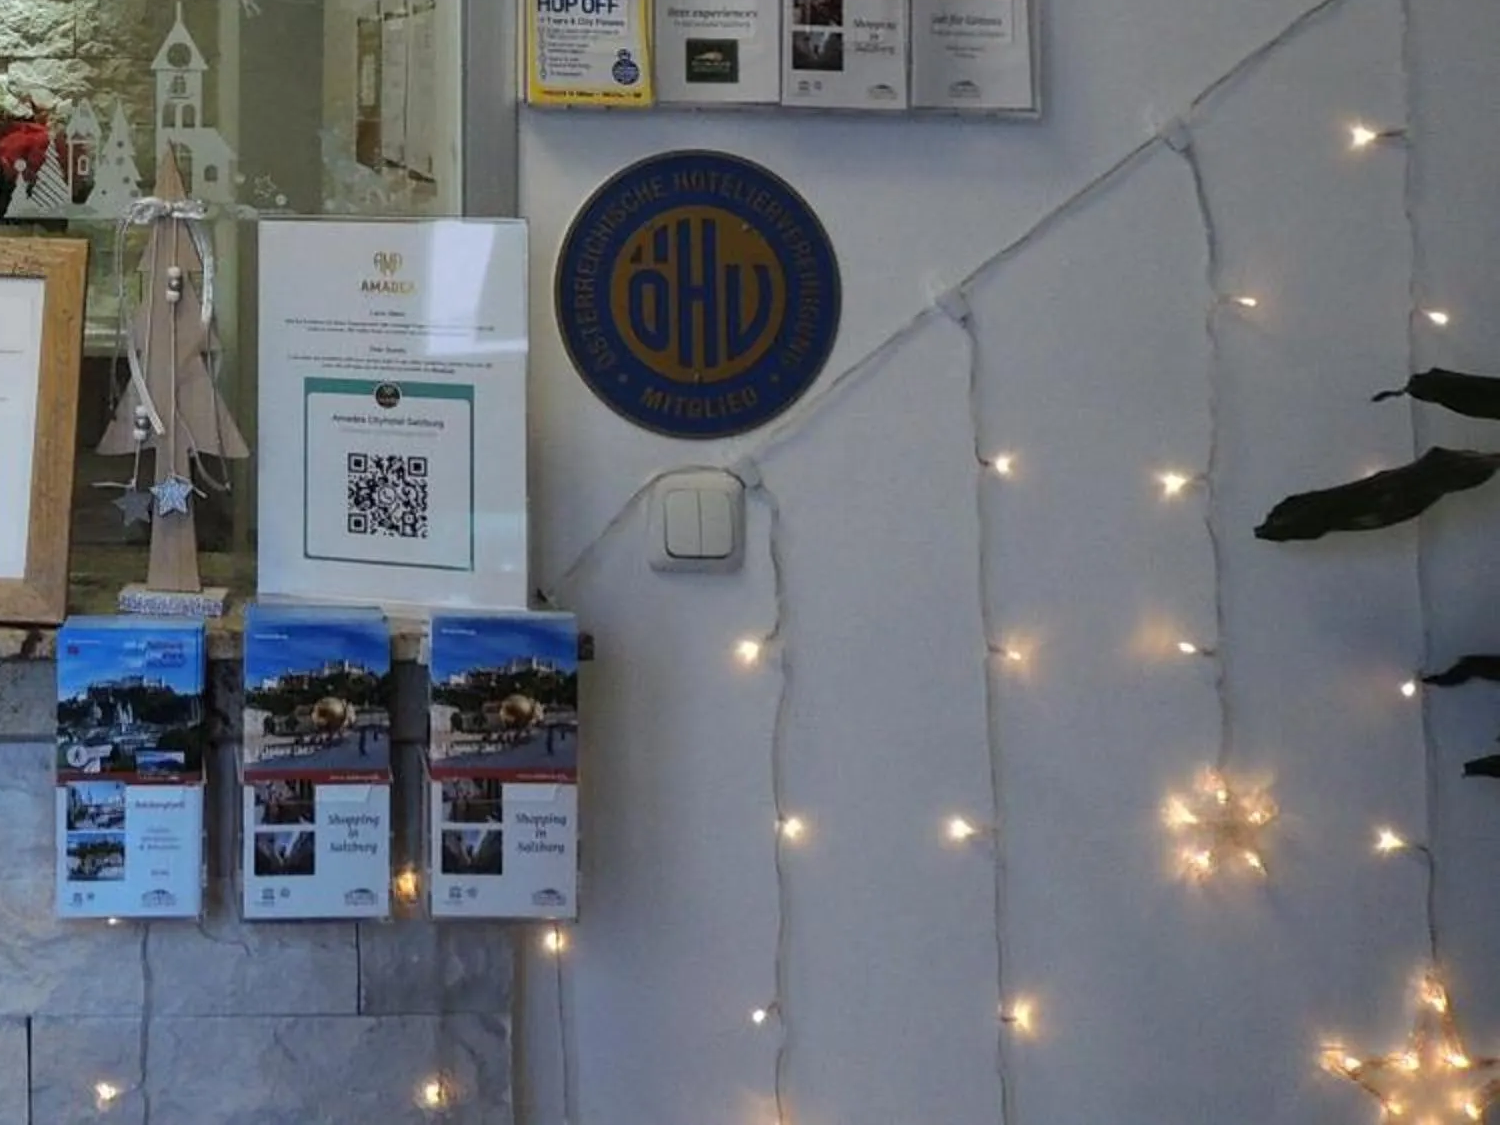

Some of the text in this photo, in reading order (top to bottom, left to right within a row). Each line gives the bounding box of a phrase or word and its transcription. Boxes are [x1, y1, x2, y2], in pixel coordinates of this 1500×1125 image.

[639, 386, 759, 420] MITGLIED
[328, 814, 380, 828] Shopping
[515, 813, 567, 828] Shopping
[329, 840, 378, 855] Salzburg
[516, 841, 566, 855] Salzburg
